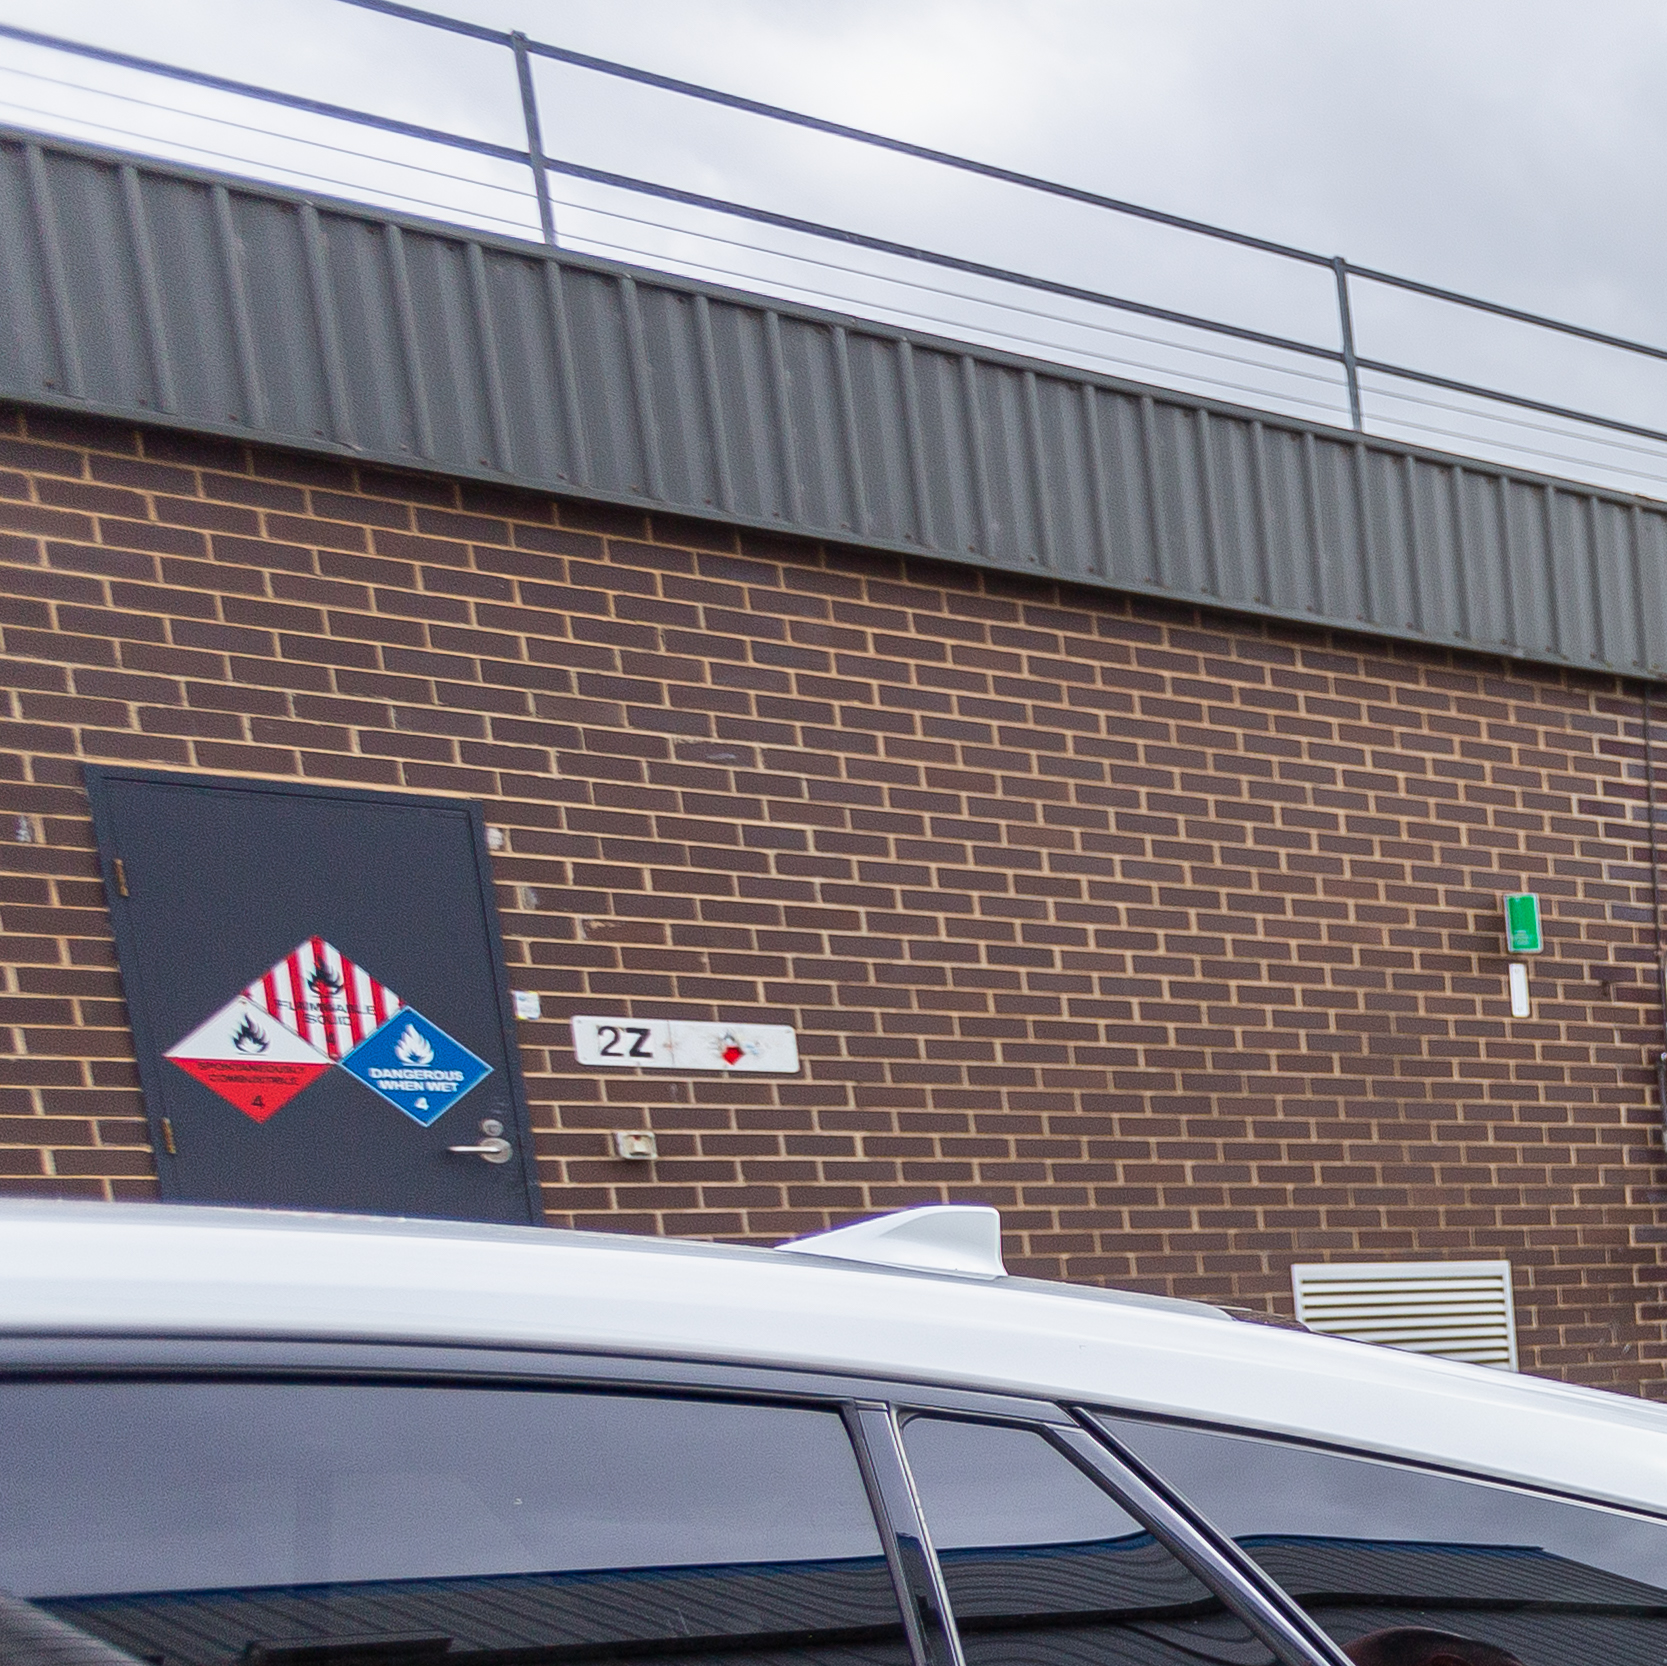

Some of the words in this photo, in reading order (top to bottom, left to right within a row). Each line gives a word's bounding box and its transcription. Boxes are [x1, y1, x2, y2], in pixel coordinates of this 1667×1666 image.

[597, 1025, 654, 1059] 2Z
[368, 1067, 465, 1082] DANGEROUS
[377, 1079, 424, 1092] WHEN
[425, 1080, 460, 1093] WET
[251, 1095, 266, 1110] 4
[413, 1096, 431, 1112] 4
